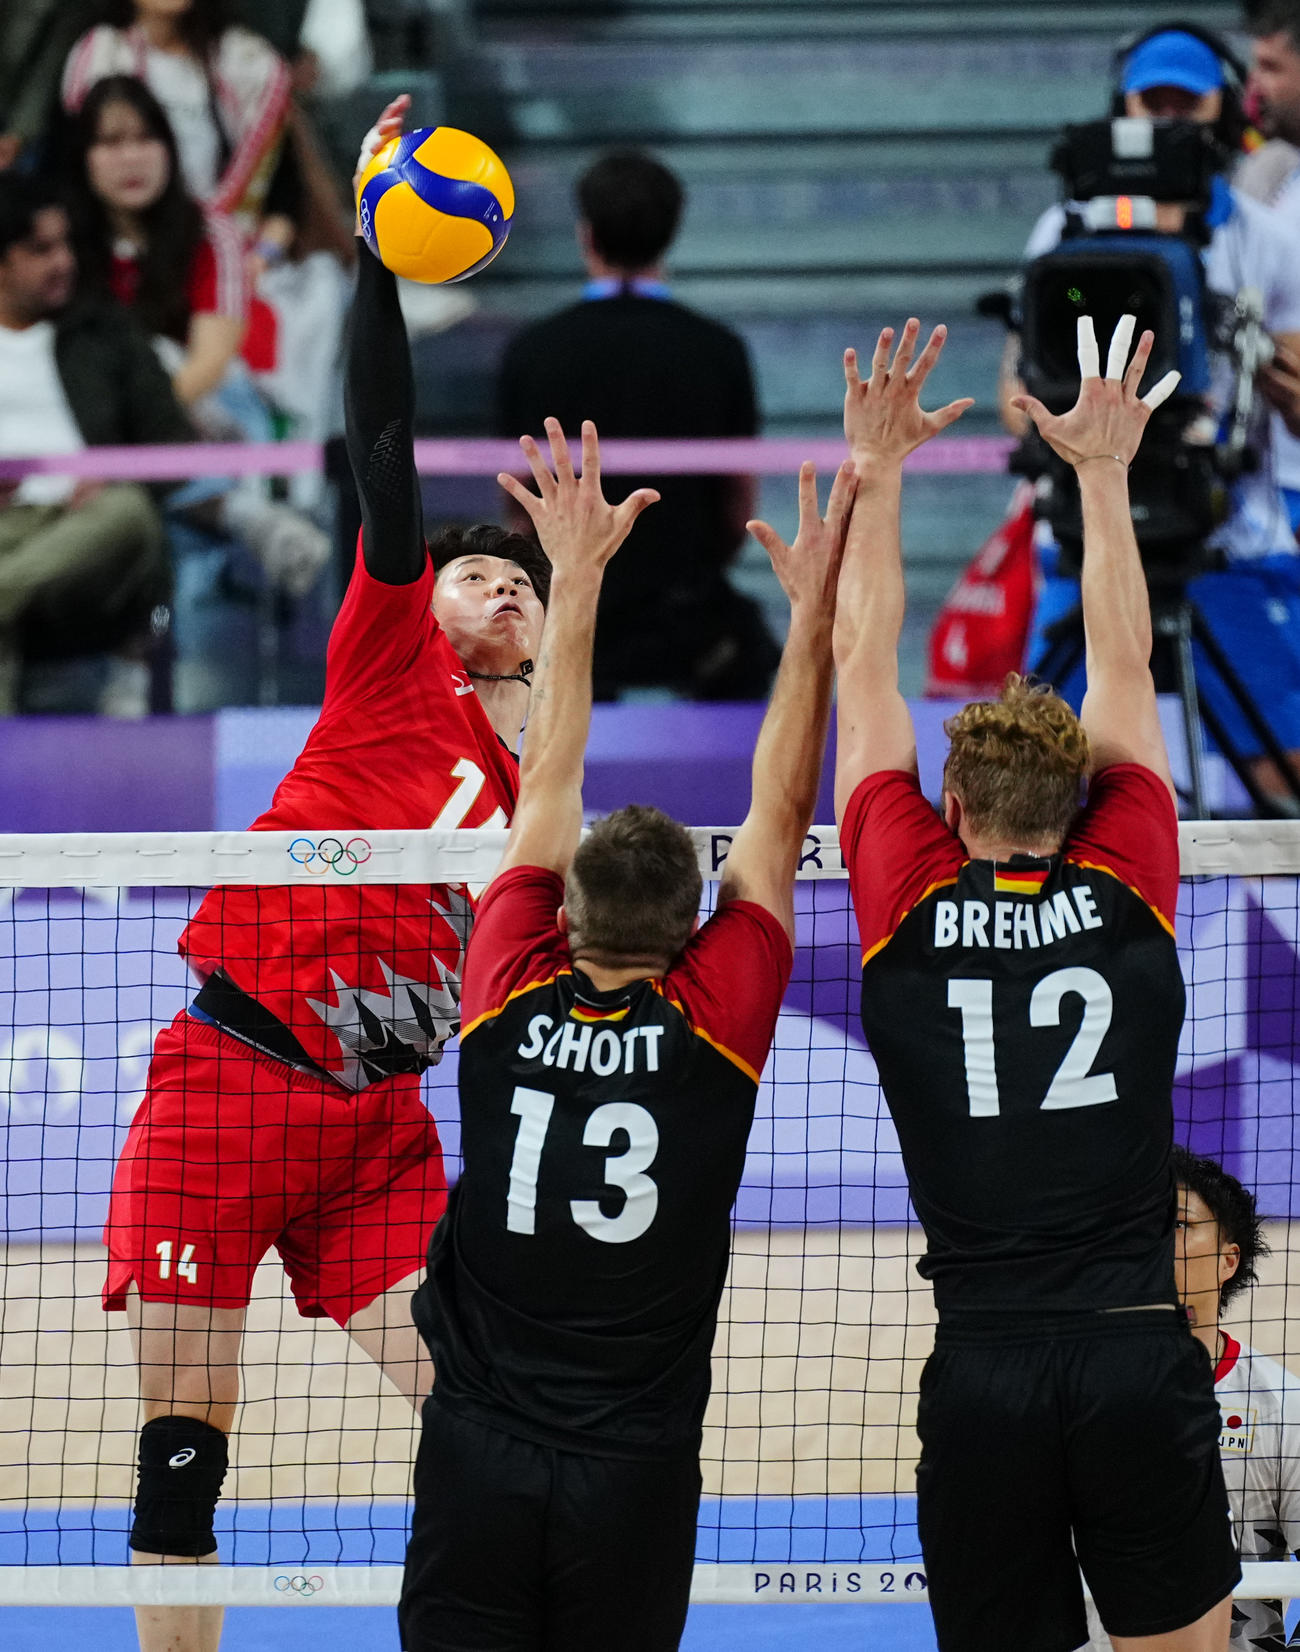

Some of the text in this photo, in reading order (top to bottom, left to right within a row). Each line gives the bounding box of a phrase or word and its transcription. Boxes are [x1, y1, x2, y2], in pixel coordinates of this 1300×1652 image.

[934, 885, 1103, 950] BREHME
[947, 966, 1119, 1117] 12
[506, 1086, 659, 1243] 13
[156, 1240, 198, 1284] 14
[1218, 1436, 1245, 1449] JPN
